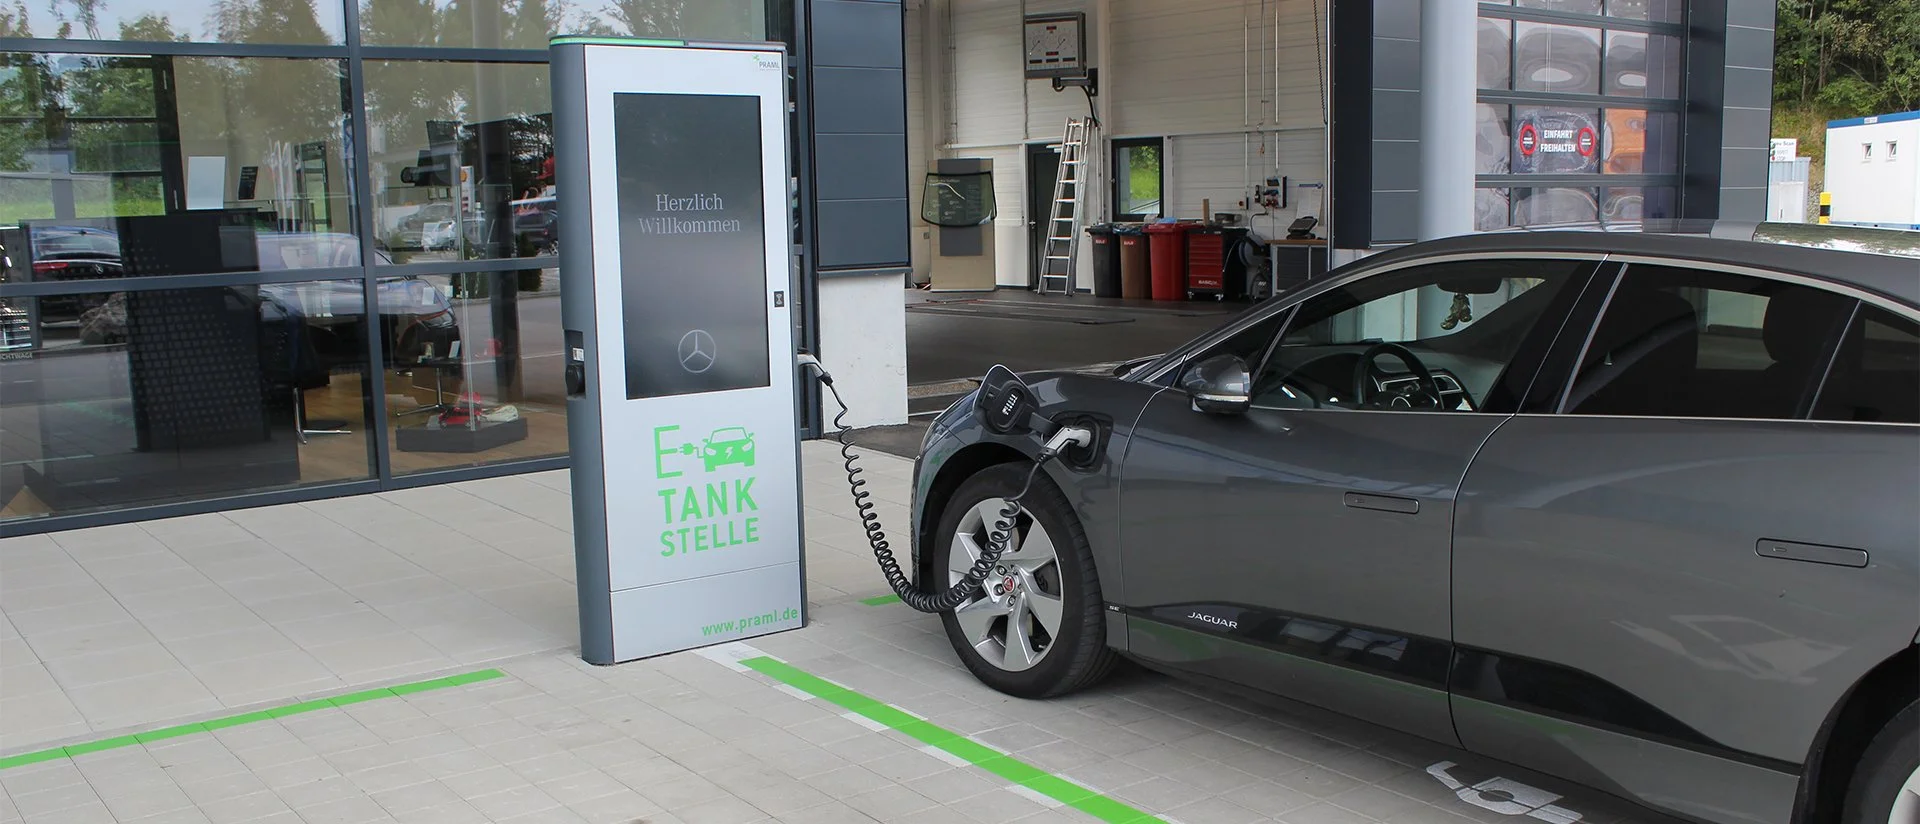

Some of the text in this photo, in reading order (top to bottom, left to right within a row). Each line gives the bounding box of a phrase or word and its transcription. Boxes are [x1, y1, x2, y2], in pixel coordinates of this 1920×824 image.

[758, 61, 780, 69] PRAML
[1543, 129, 1573, 139] EINFAHRT
[1540, 143, 1576, 153] FREIHALTEN
[656, 193, 724, 212] Herzlich
[639, 217, 741, 235] Willkommen
[654, 424, 683, 479] E
[658, 477, 758, 525] TANK
[660, 517, 760, 558] STELLE
[702, 607, 799, 637] www.praml.de
[1187, 611, 1239, 630] JAGUAR
